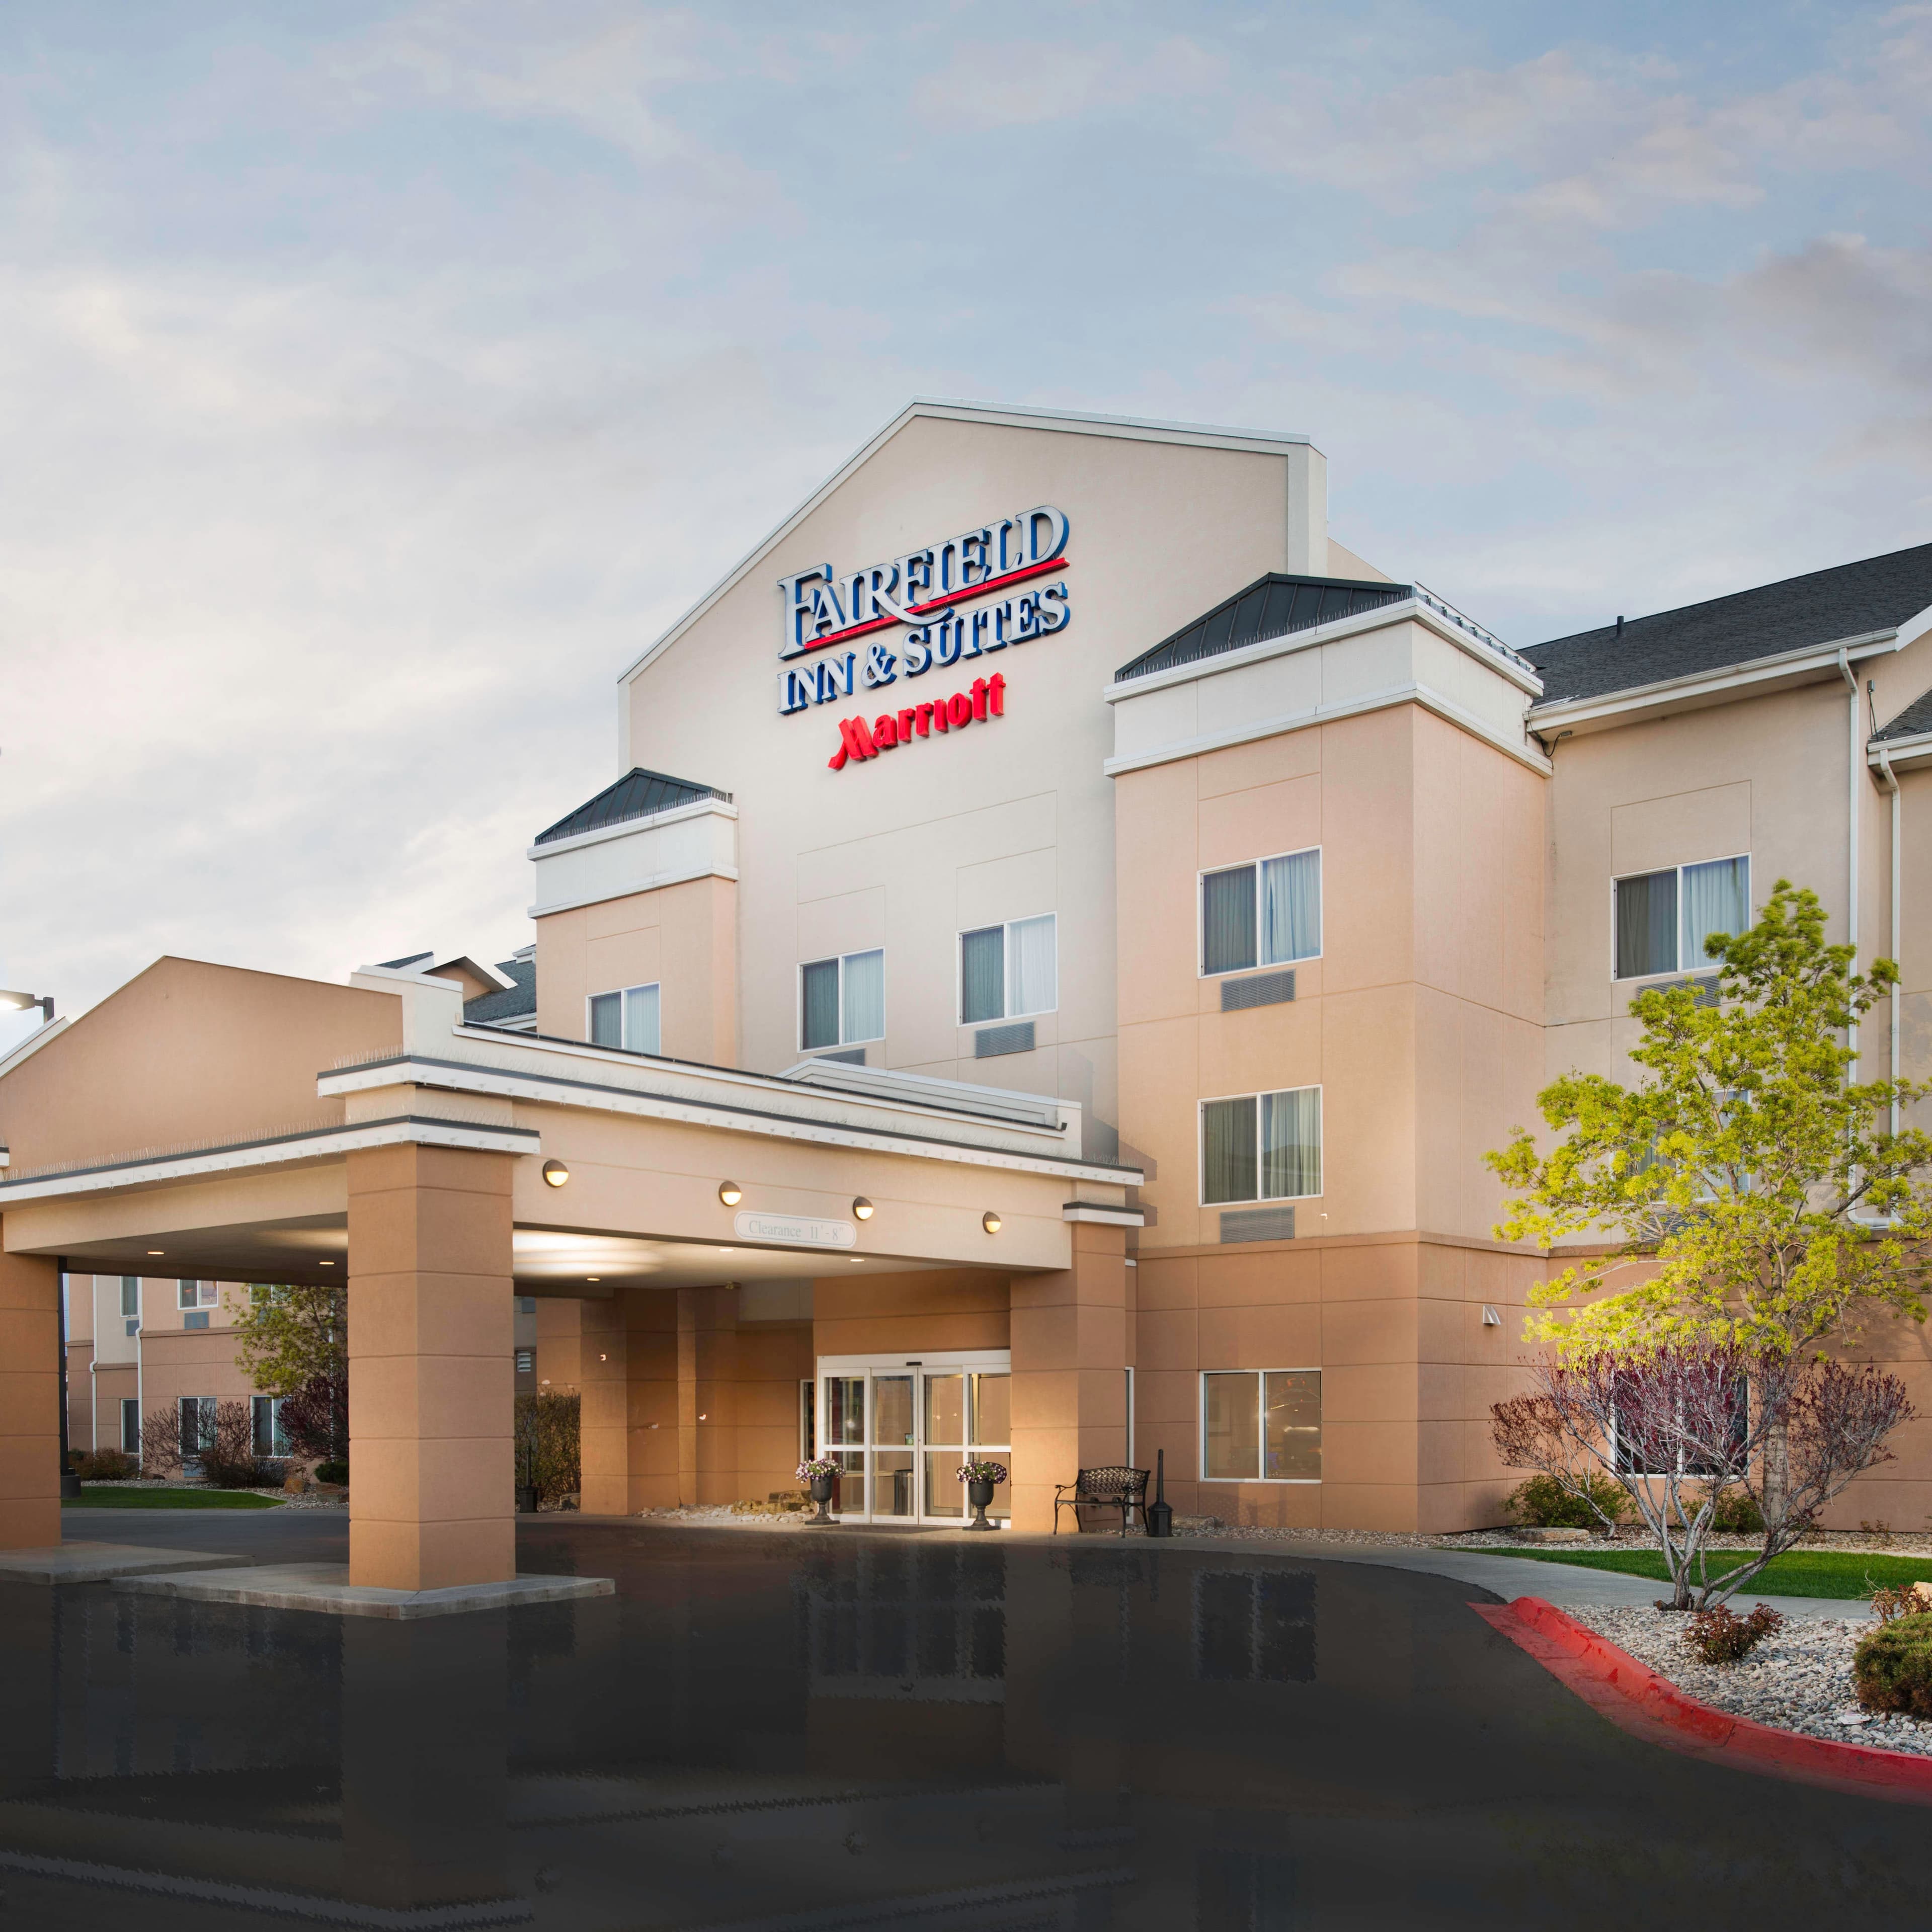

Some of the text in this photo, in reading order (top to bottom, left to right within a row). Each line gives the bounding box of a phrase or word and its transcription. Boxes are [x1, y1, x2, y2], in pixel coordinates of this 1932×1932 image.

[777, 505, 1070, 660] FAIRFIELD
[777, 582, 1070, 714] INN & SUITES
[828, 672, 1006, 770] Marriott
[749, 1220, 801, 1238] Clearance
